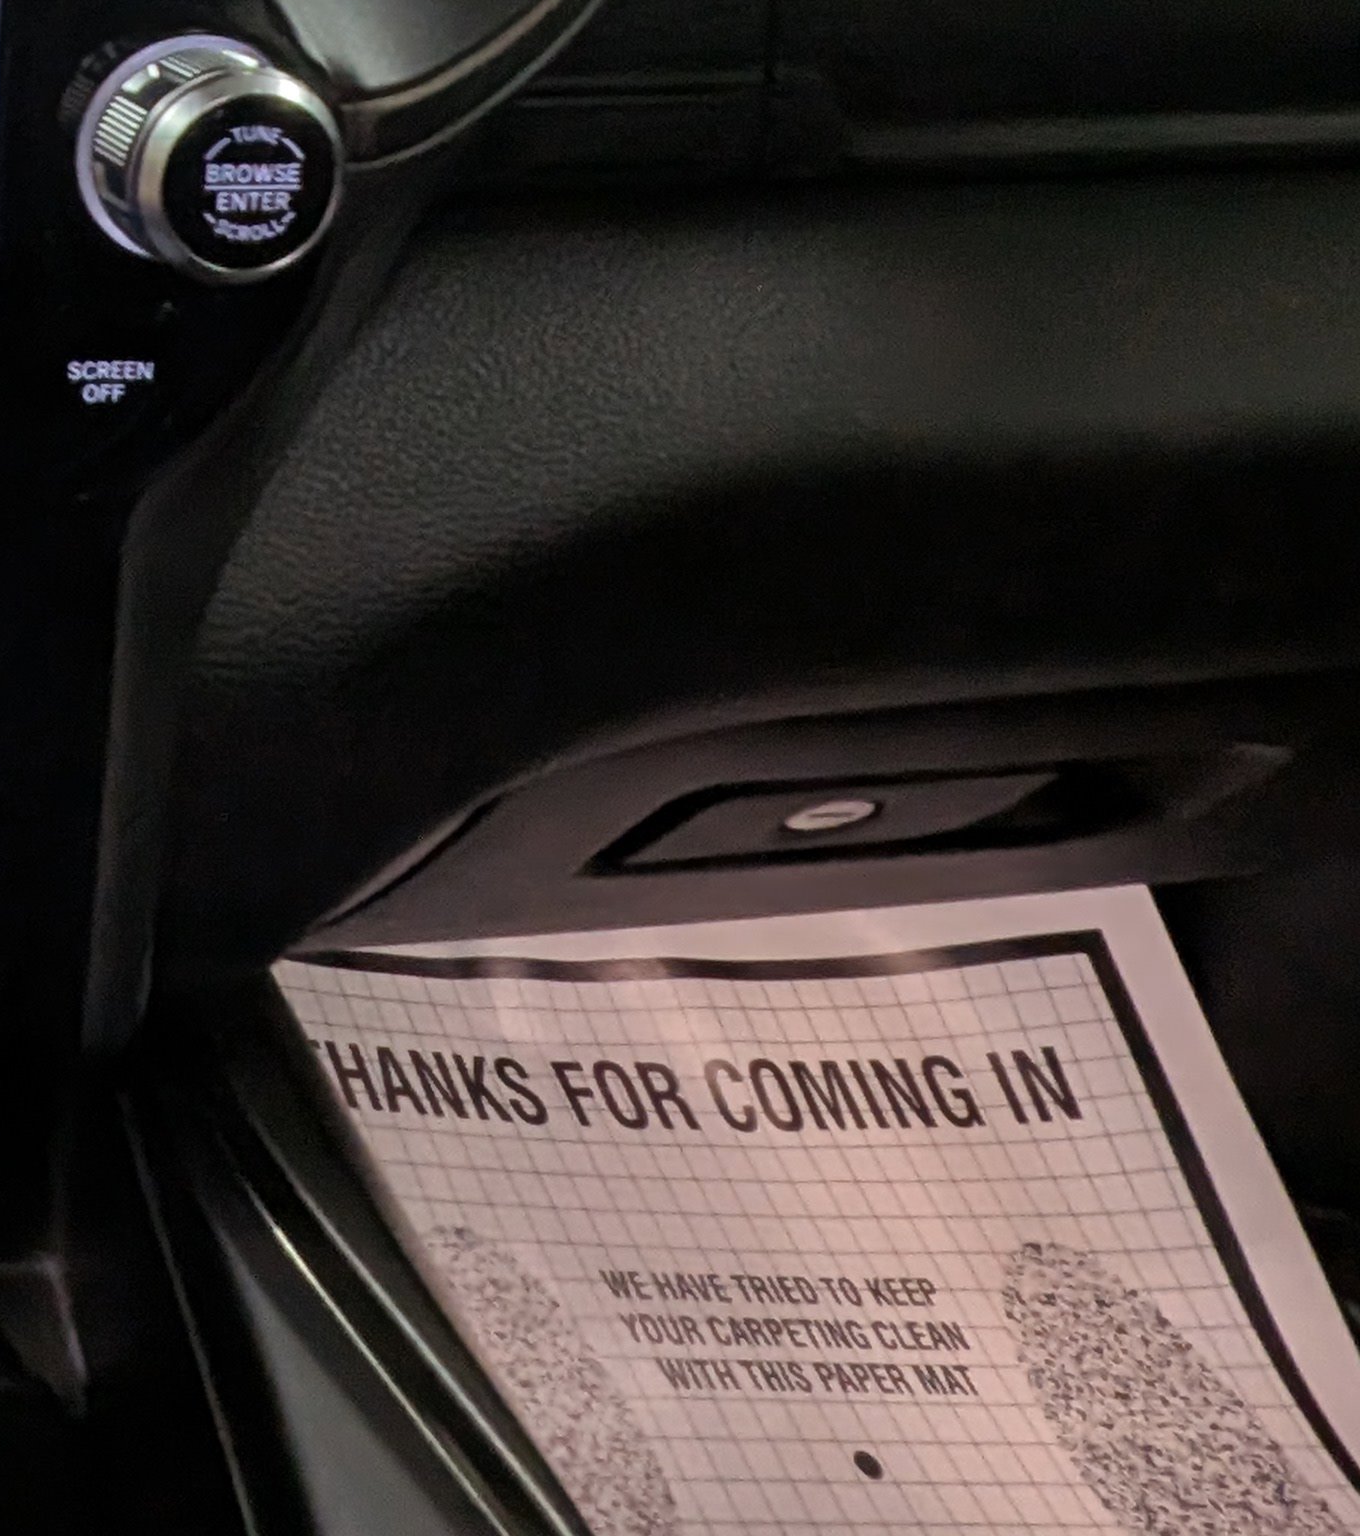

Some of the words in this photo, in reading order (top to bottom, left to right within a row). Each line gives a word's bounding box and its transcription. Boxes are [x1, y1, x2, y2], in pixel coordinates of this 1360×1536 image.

[229, 125, 285, 147] TUNE
[204, 163, 302, 183] BROWSE
[215, 191, 292, 213] ENTER
[213, 216, 287, 242] SCROLL
[66, 360, 155, 381] SCREEN
[82, 383, 126, 404] OFF
[310, 1040, 549, 1126] HANKS
[550, 1059, 702, 1131] FOR
[703, 1054, 987, 1133] COMING
[986, 1045, 1083, 1125] IN
[599, 1269, 653, 1300] WE
[651, 1272, 733, 1304] HAVE
[730, 1274, 820, 1305] TRIED
[818, 1276, 864, 1307] TO
[864, 1277, 938, 1307] KEEP
[618, 1312, 706, 1346] YOUR
[706, 1315, 873, 1351] CARPETING
[870, 1320, 972, 1351] CLEAN
[654, 1357, 741, 1392] WITH
[739, 1360, 814, 1394] THIS
[817, 1363, 915, 1395] PAPER
[913, 1364, 981, 1396] MAT
